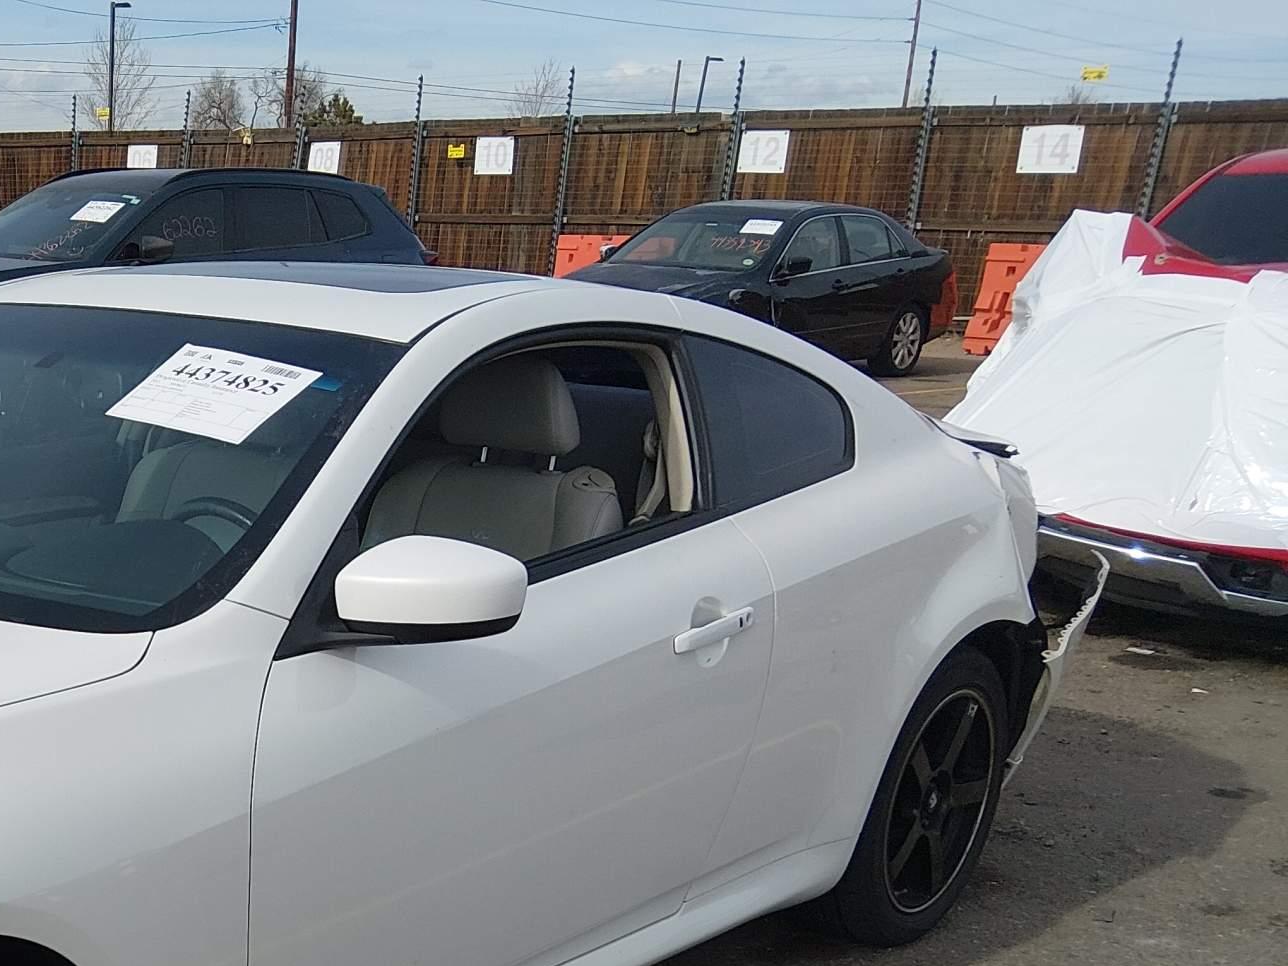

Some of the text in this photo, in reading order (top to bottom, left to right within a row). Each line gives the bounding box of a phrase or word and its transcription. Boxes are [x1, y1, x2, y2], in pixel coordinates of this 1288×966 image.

[132, 150, 152, 168] 06
[314, 147, 333, 170] 08
[480, 141, 507, 168] 10
[749, 136, 780, 166] 12
[1033, 132, 1070, 167] 14
[172, 363, 286, 396] 44374825
